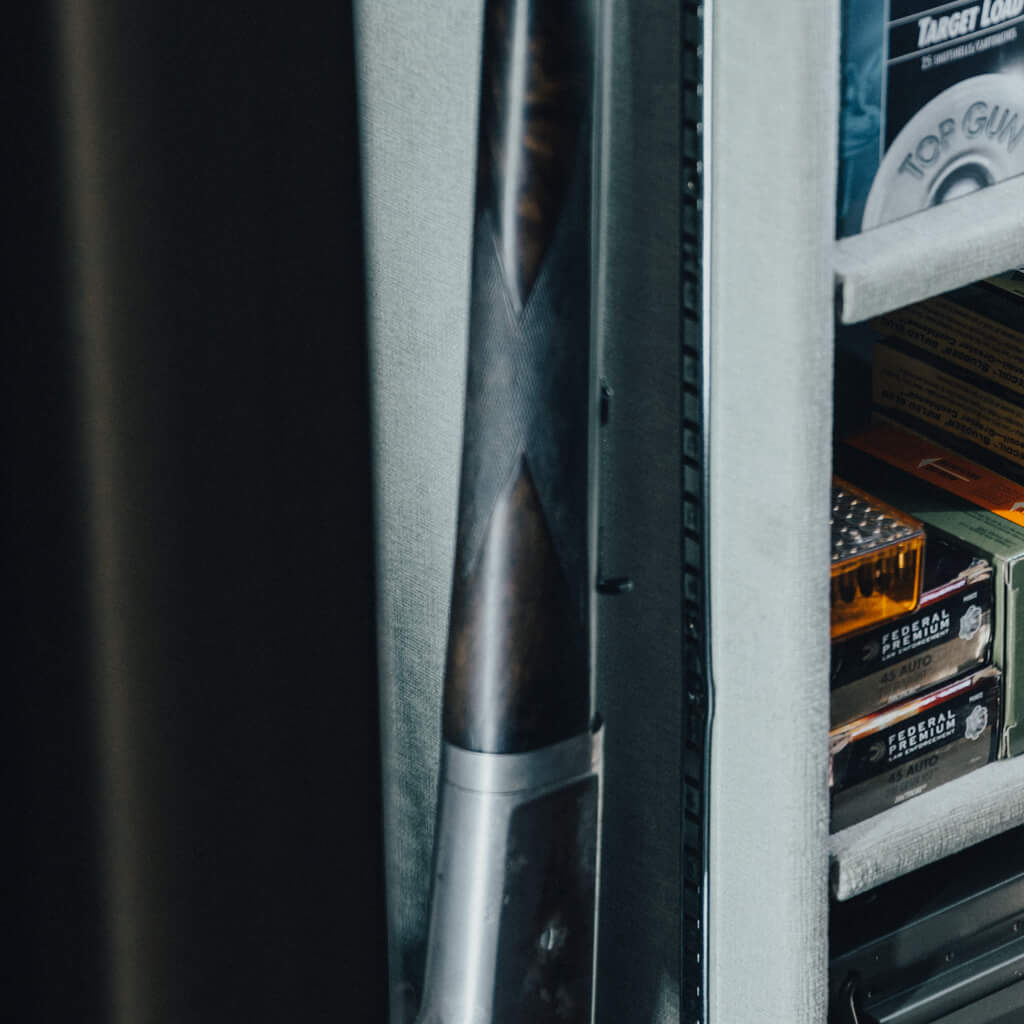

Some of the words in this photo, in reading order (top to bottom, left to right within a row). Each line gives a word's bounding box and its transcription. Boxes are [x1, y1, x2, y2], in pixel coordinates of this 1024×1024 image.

[917, 4, 981, 49] TARGET
[898, 117, 956, 180] TOP
[881, 608, 950, 645] FEDERAL
[881, 618, 950, 655] PREMIUM
[902, 655, 932, 674] AUTO
[888, 709, 956, 746] FEDERAL
[888, 718, 956, 756] PREMIUM
[907, 755, 939, 775] AUTO
